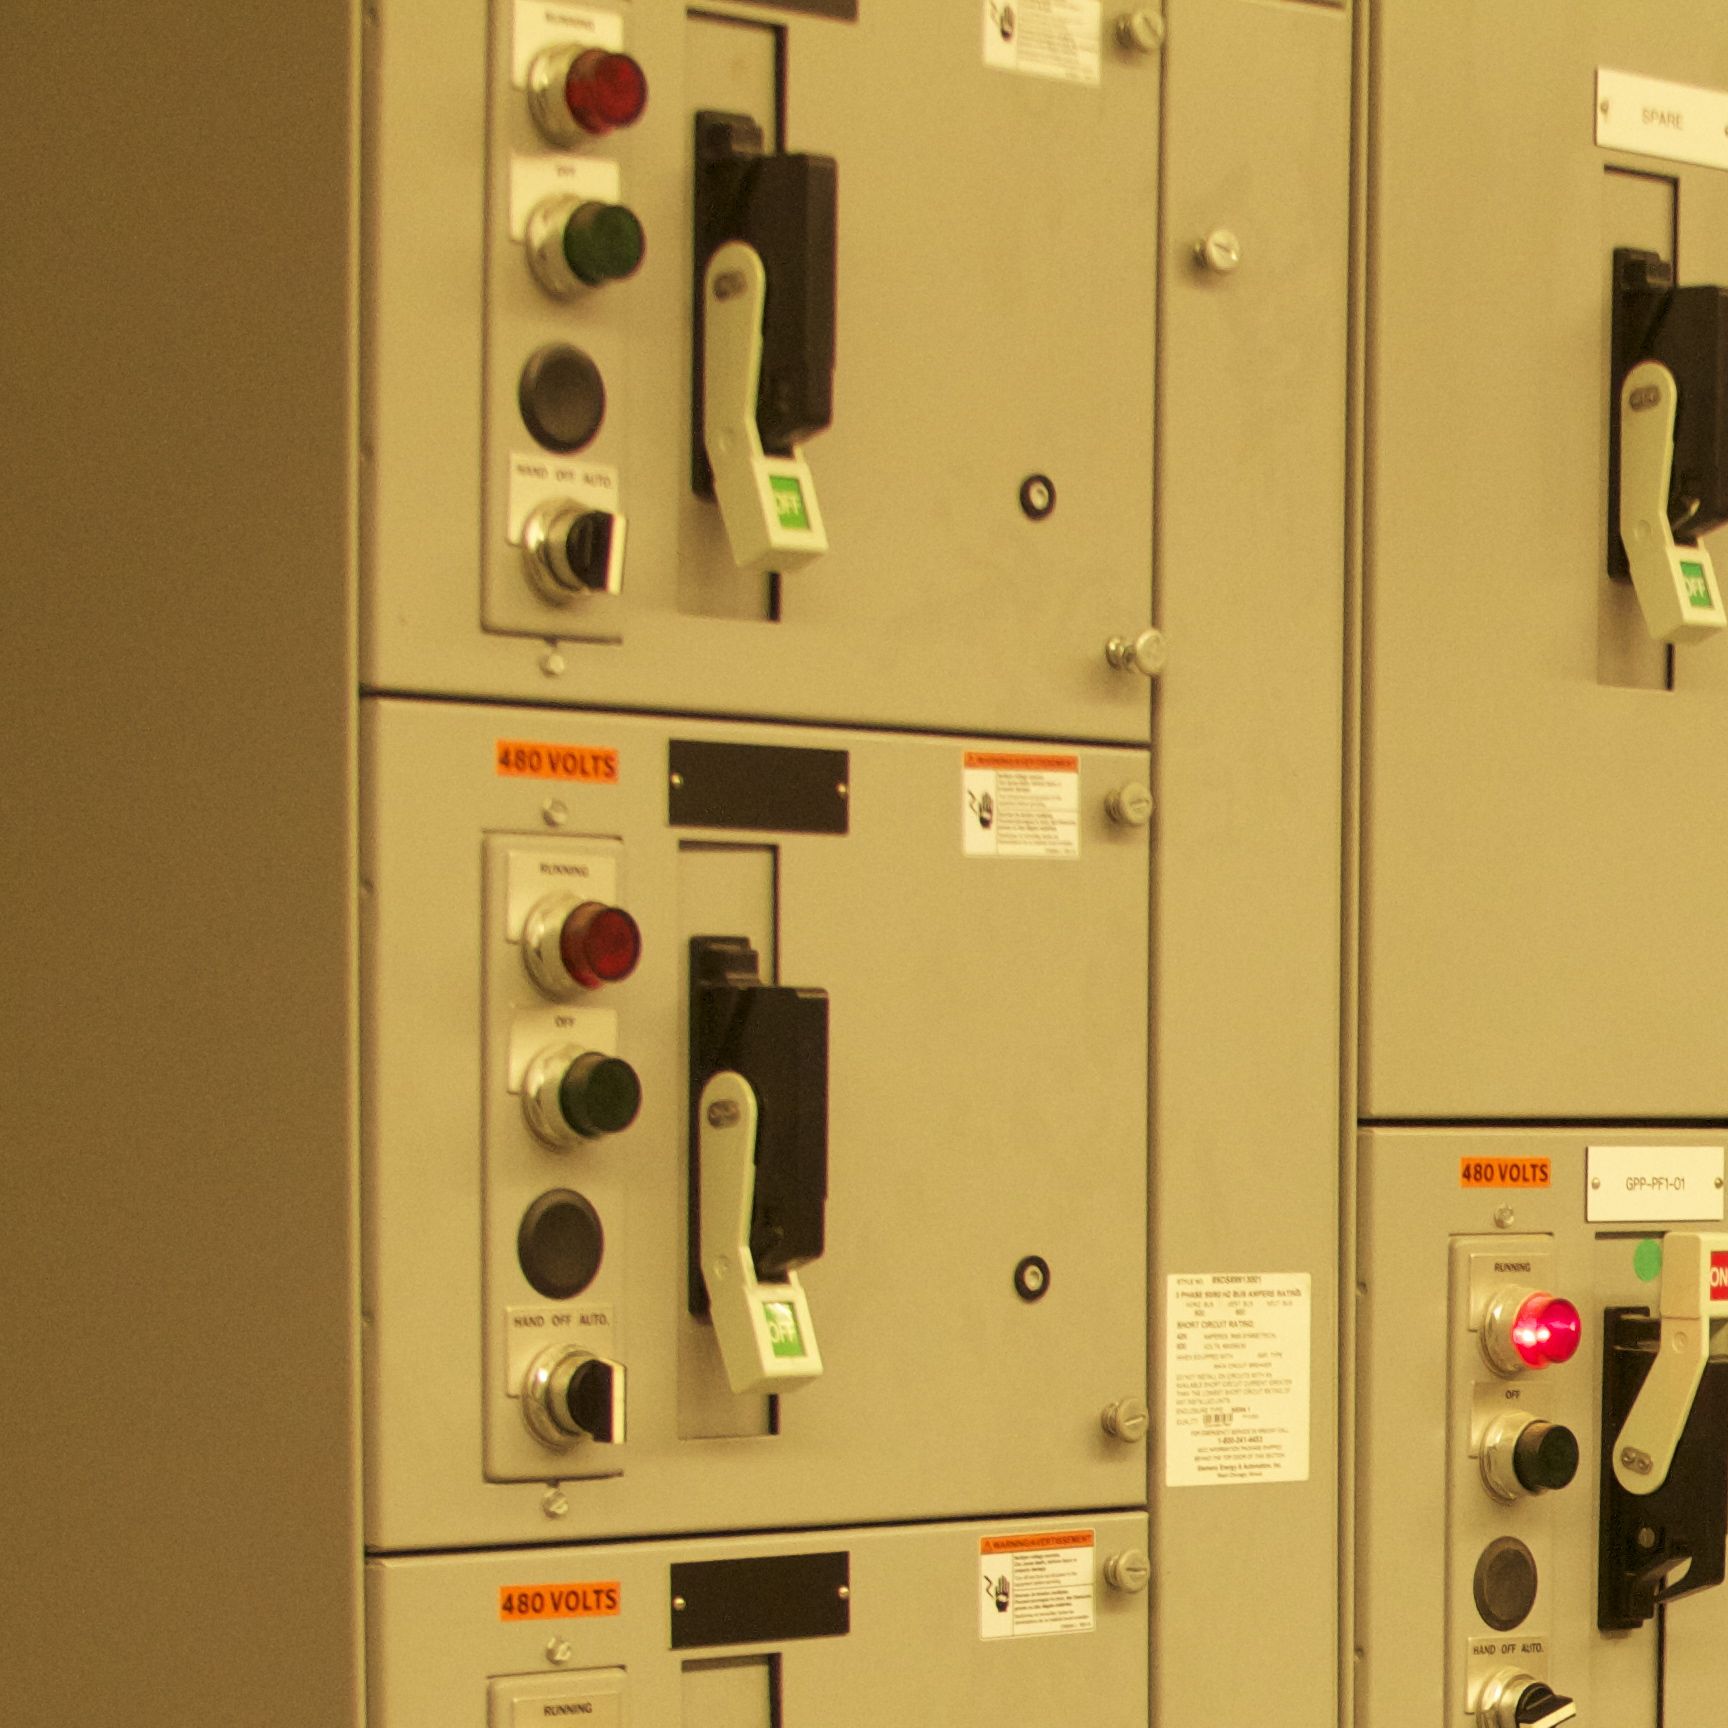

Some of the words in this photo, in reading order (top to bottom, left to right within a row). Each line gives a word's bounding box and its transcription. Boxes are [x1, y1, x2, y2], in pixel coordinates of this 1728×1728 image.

[1642, 108, 1681, 130] SPARE
[498, 747, 541, 771] 480
[548, 751, 614, 777] VOLTS
[540, 864, 588, 877] RUNNING
[554, 1015, 574, 1027] OFF
[1462, 1163, 1493, 1181] 480
[1499, 1164, 1547, 1181] VOLTS
[1626, 1177, 1684, 1191] GPP-PF1-01
[1711, 1267, 1728, 1286] ON
[514, 1316, 544, 1327] HAND
[552, 1315, 571, 1326] OFF
[768, 1320, 795, 1345] OFF
[502, 1592, 543, 1614] 480
[550, 1588, 616, 1612] VOLTS
[544, 1703, 592, 1716] RUNNING
